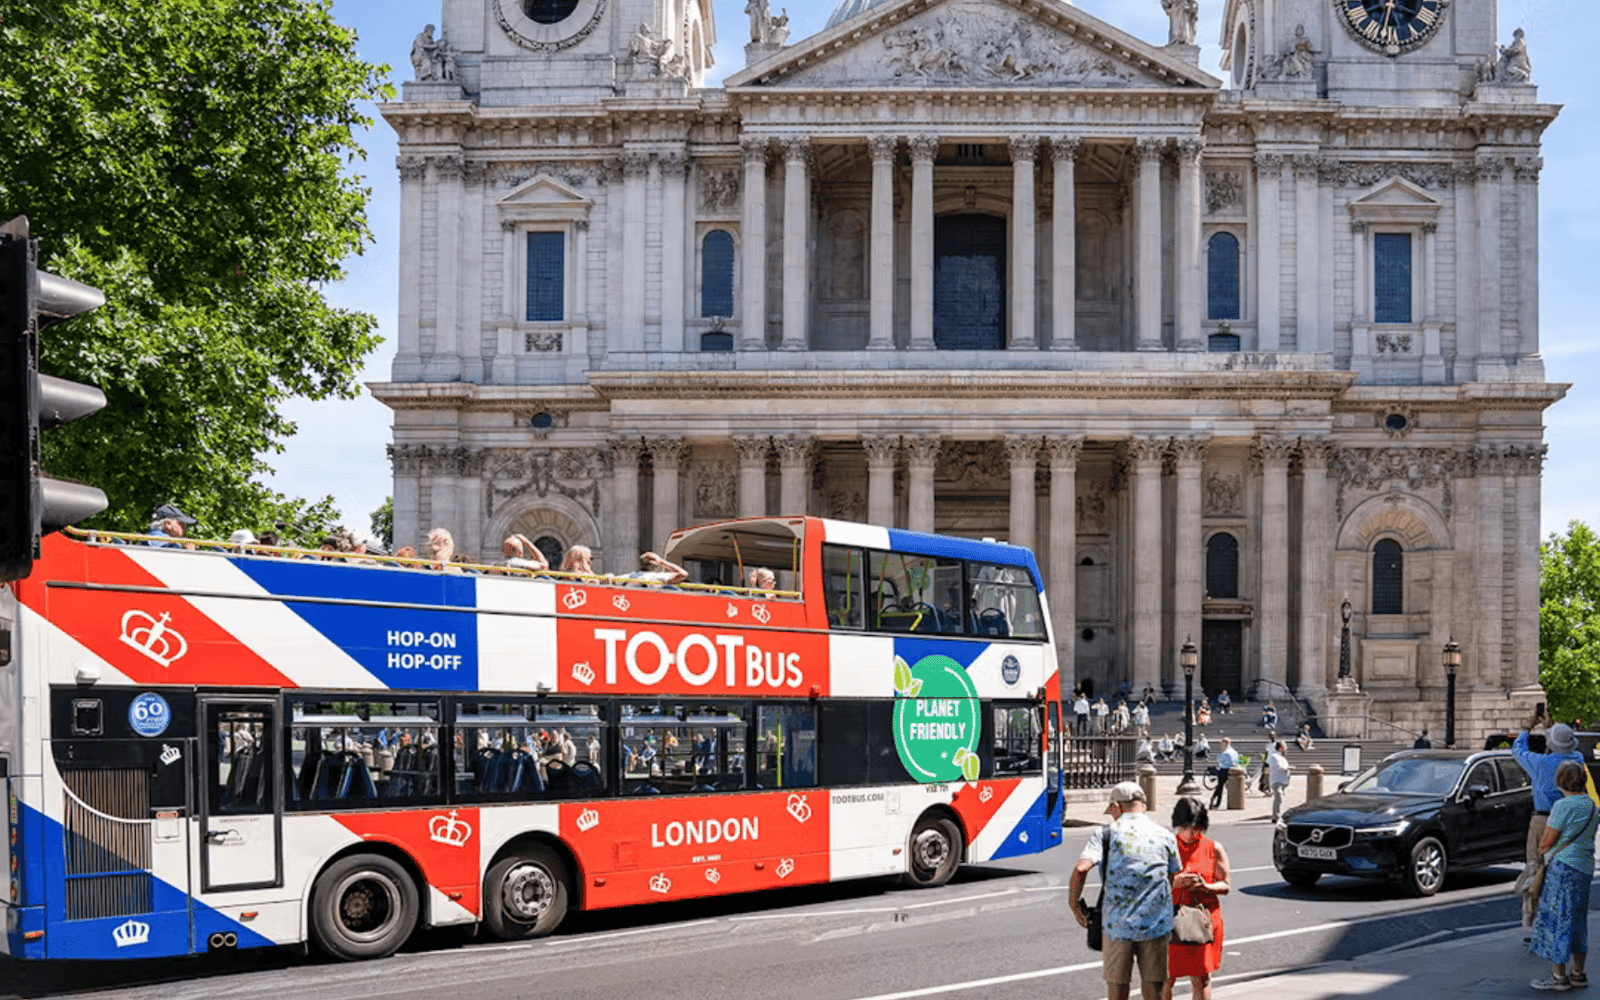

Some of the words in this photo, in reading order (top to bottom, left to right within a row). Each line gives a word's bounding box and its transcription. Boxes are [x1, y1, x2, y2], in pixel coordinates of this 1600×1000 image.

[387, 630, 456, 648] HOP-ON
[387, 652, 462, 670] HOP-OFF
[135, 701, 163, 720] 60
[916, 699, 960, 717] PLANET
[909, 722, 966, 740] FRIENDLY
[832, 793, 885, 804] TOOTBUS.COM
[651, 816, 759, 847] LONDON
